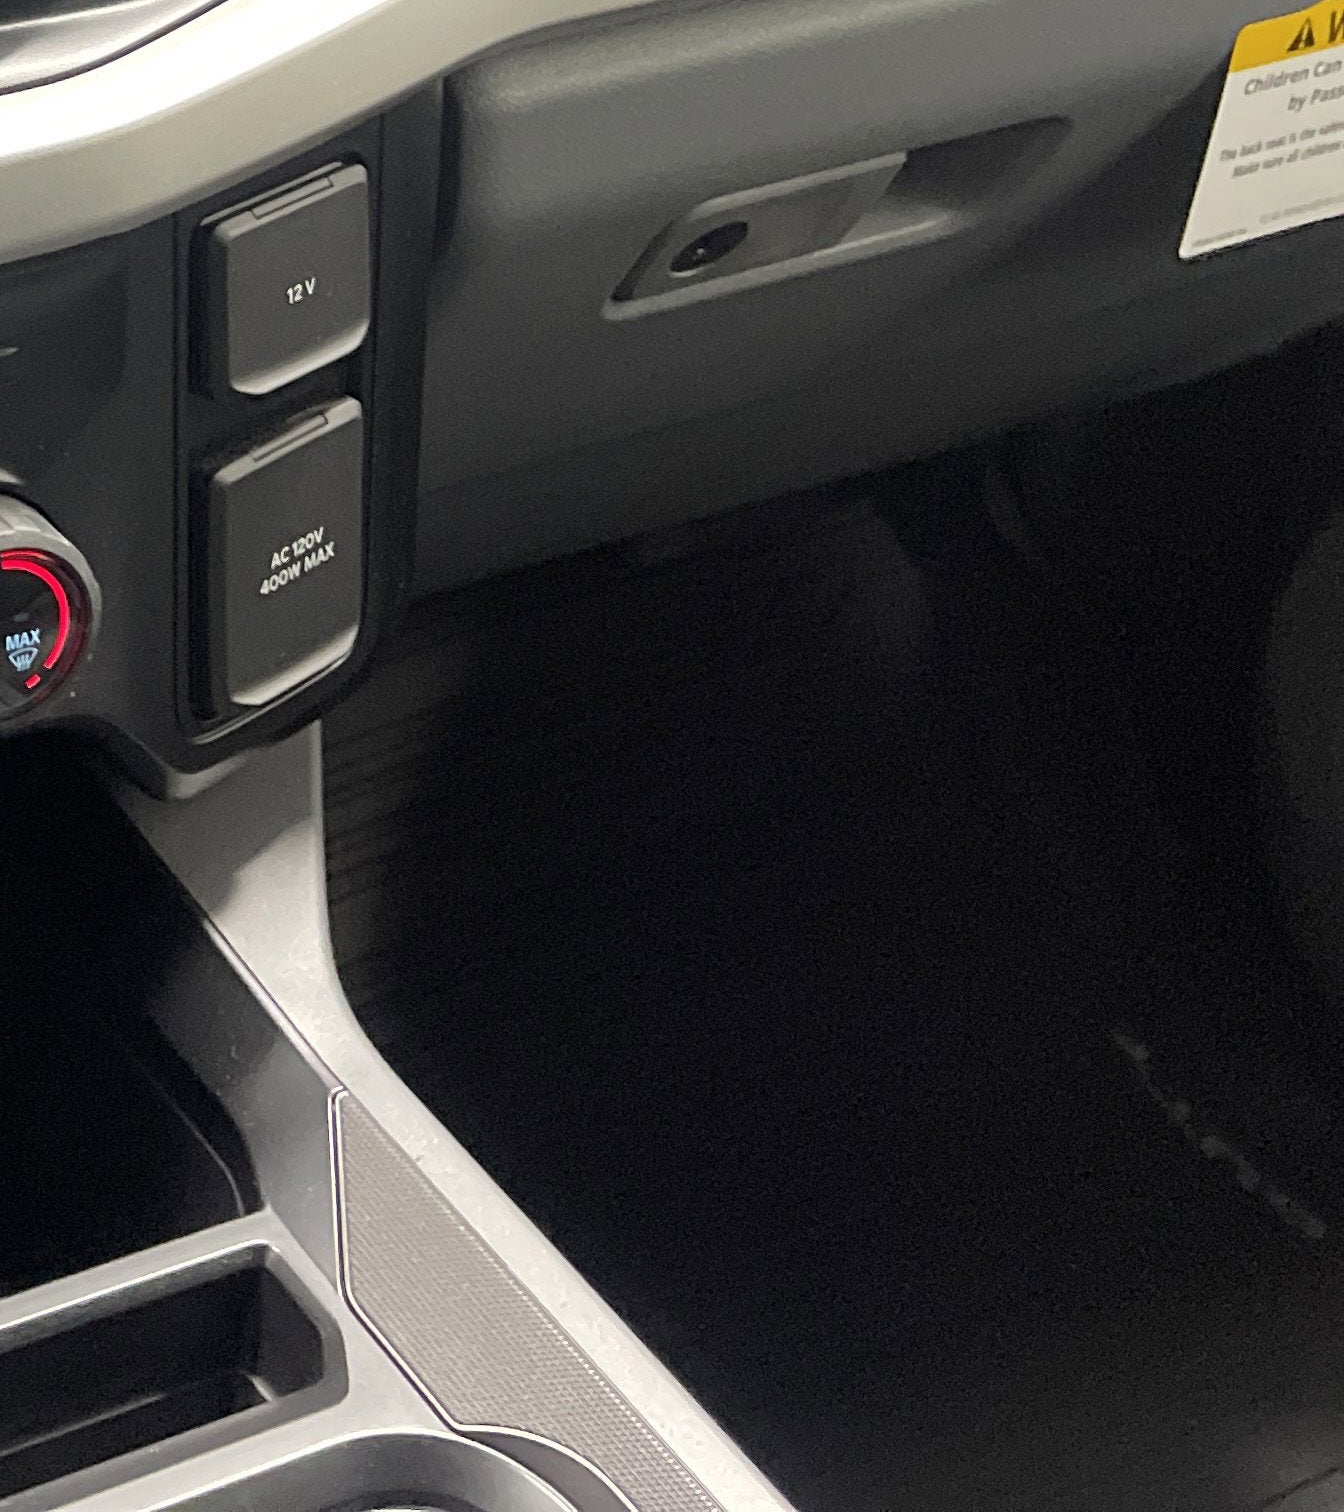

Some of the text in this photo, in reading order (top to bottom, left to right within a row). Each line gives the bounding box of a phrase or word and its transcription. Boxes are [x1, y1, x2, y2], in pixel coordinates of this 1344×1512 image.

[1244, 68, 1310, 95] Children
[286, 277, 317, 305] 12 V
[271, 526, 324, 570] AC 120V
[260, 541, 336, 595] 400W MAX
[6, 628, 41, 651] MAX
